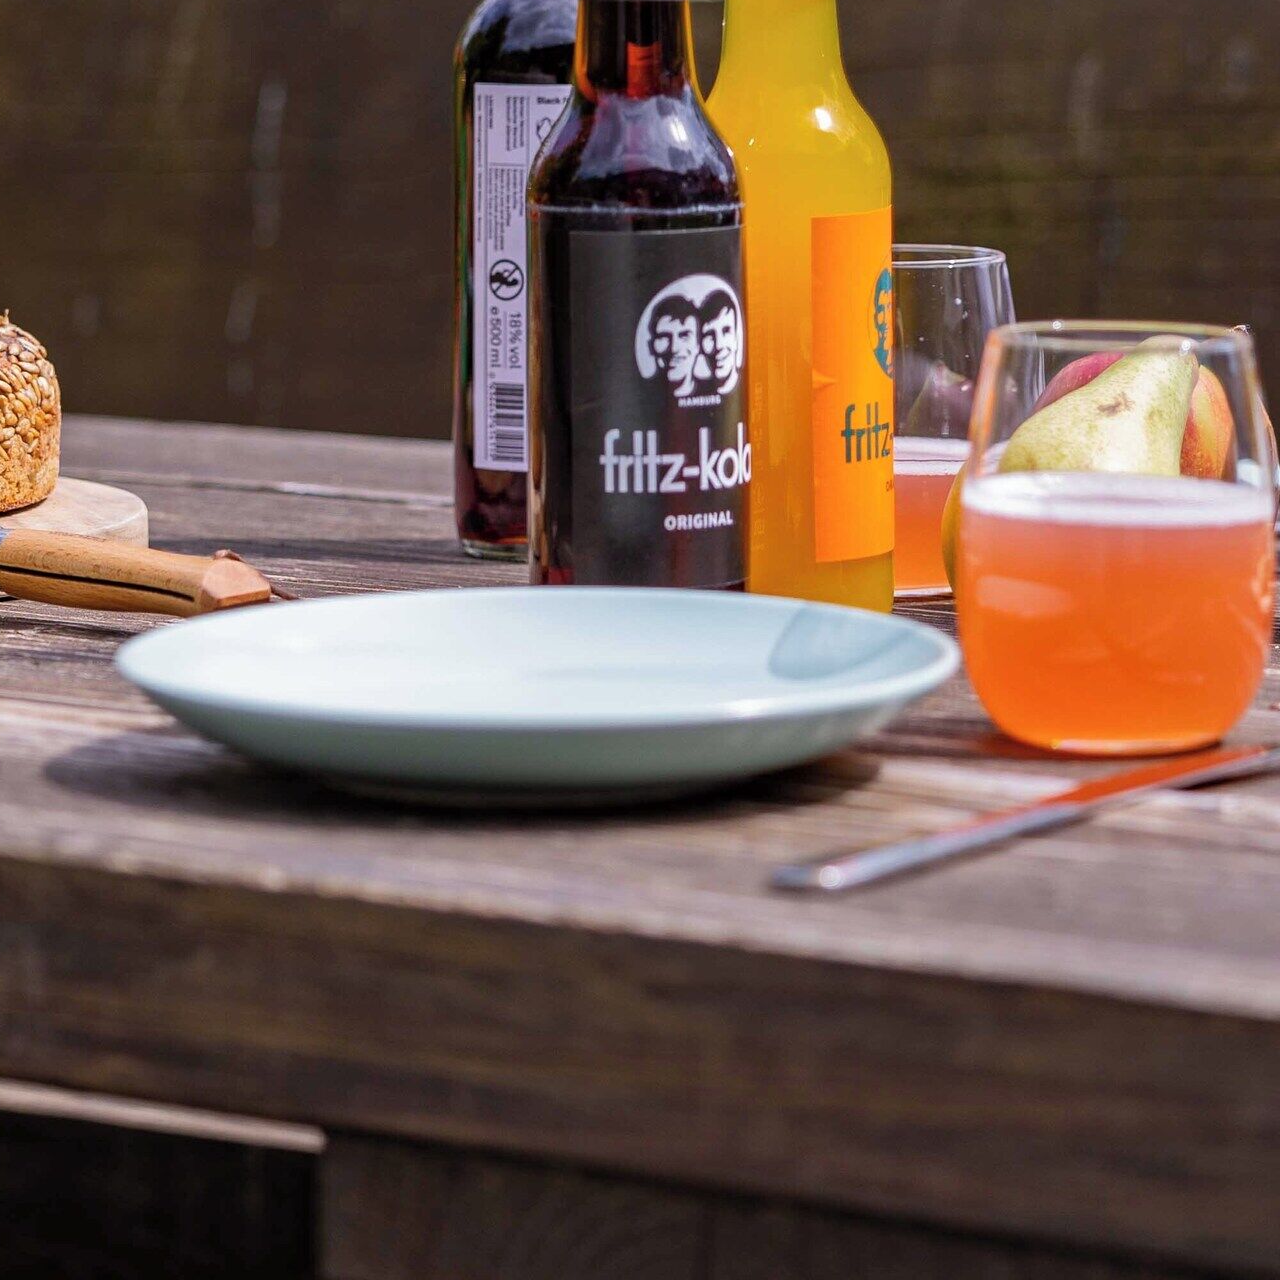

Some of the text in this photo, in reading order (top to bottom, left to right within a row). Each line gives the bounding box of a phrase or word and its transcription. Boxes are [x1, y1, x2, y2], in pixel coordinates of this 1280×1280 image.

[490, 318, 501, 346] 500
[509, 313, 522, 369] 18% vol
[490, 349, 501, 368] ml
[678, 394, 721, 408] HAMBURG
[663, 510, 734, 531] ORIGINAL
